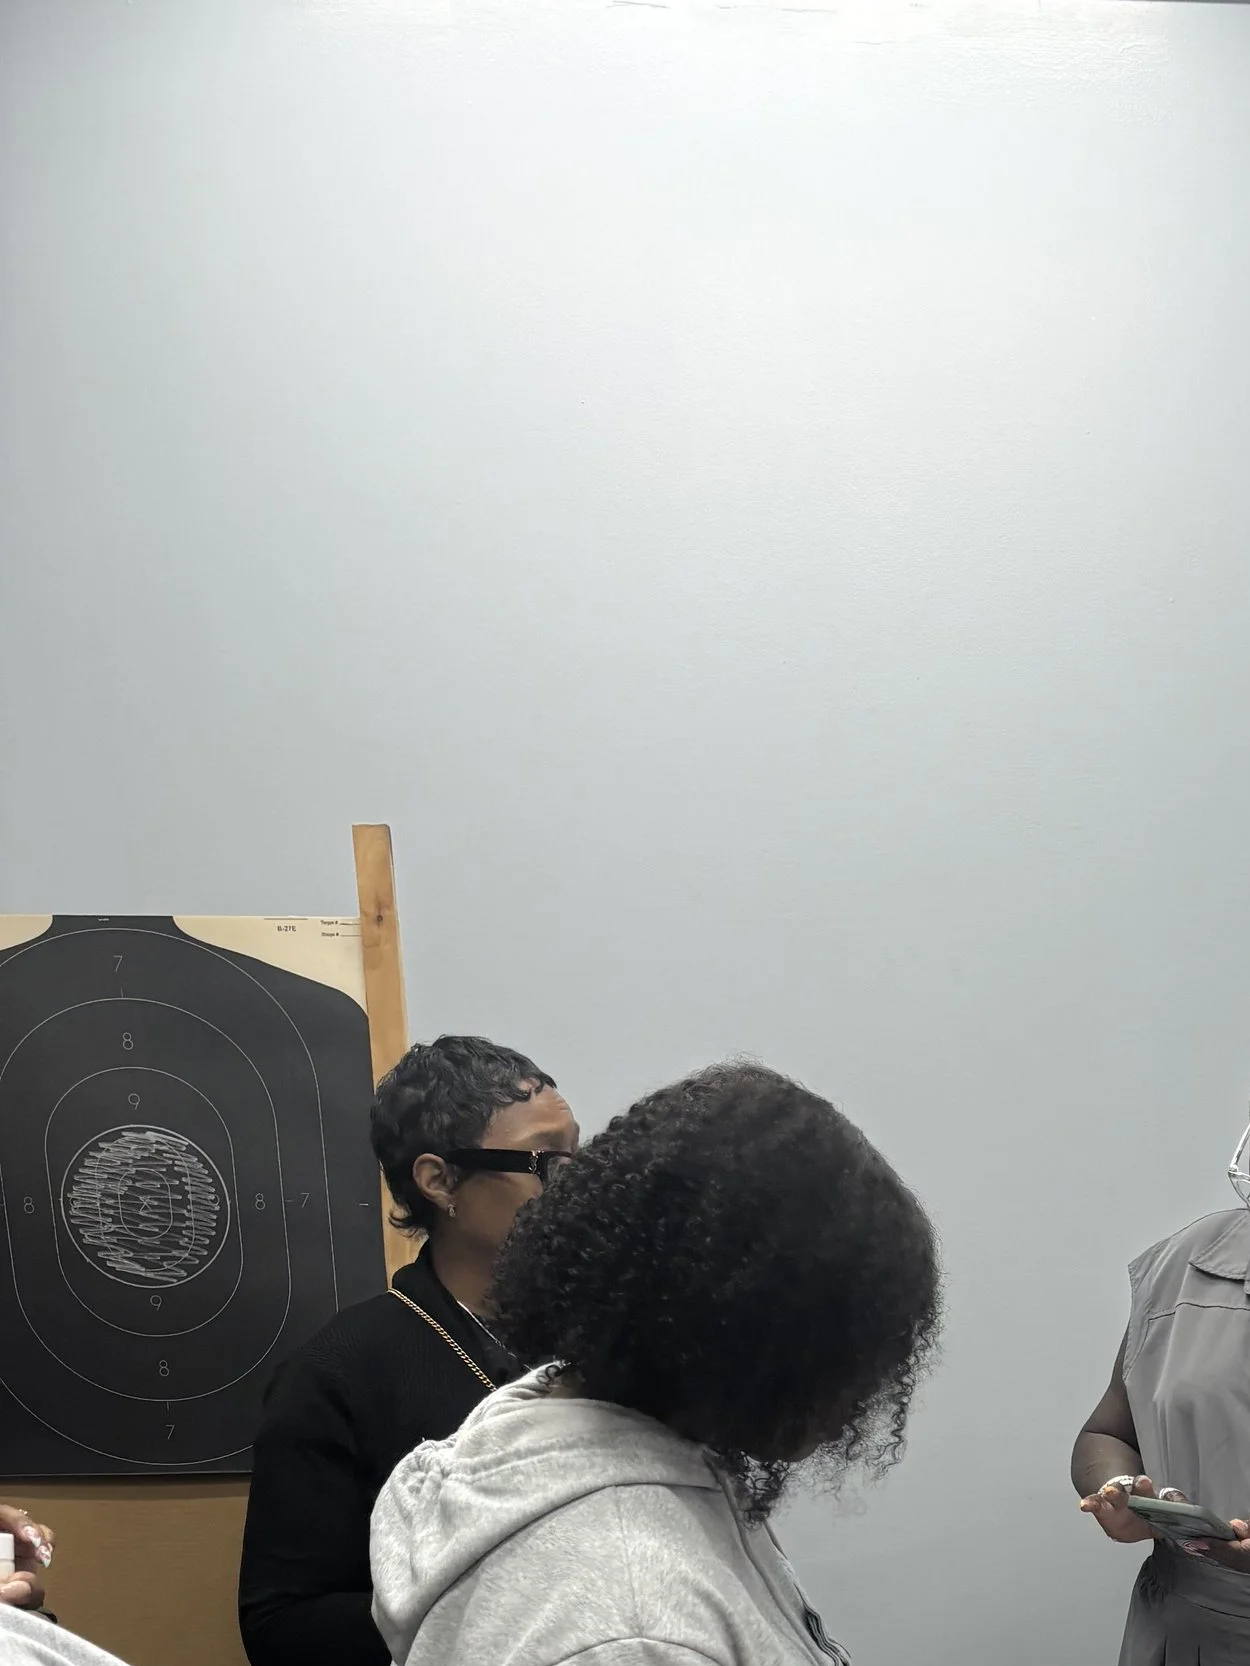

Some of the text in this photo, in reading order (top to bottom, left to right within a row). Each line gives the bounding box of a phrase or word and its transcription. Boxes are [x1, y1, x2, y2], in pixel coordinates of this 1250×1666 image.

[113, 955, 123, 972] 7
[122, 1032, 134, 1050] 8
[128, 1093, 141, 1111] 9
[23, 1196, 35, 1214] 8
[255, 1192, 266, 1210] 8
[300, 1192, 310, 1209] 7
[150, 1294, 163, 1311] 9
[158, 1359, 170, 1377] 8
[165, 1424, 175, 1440] 7
